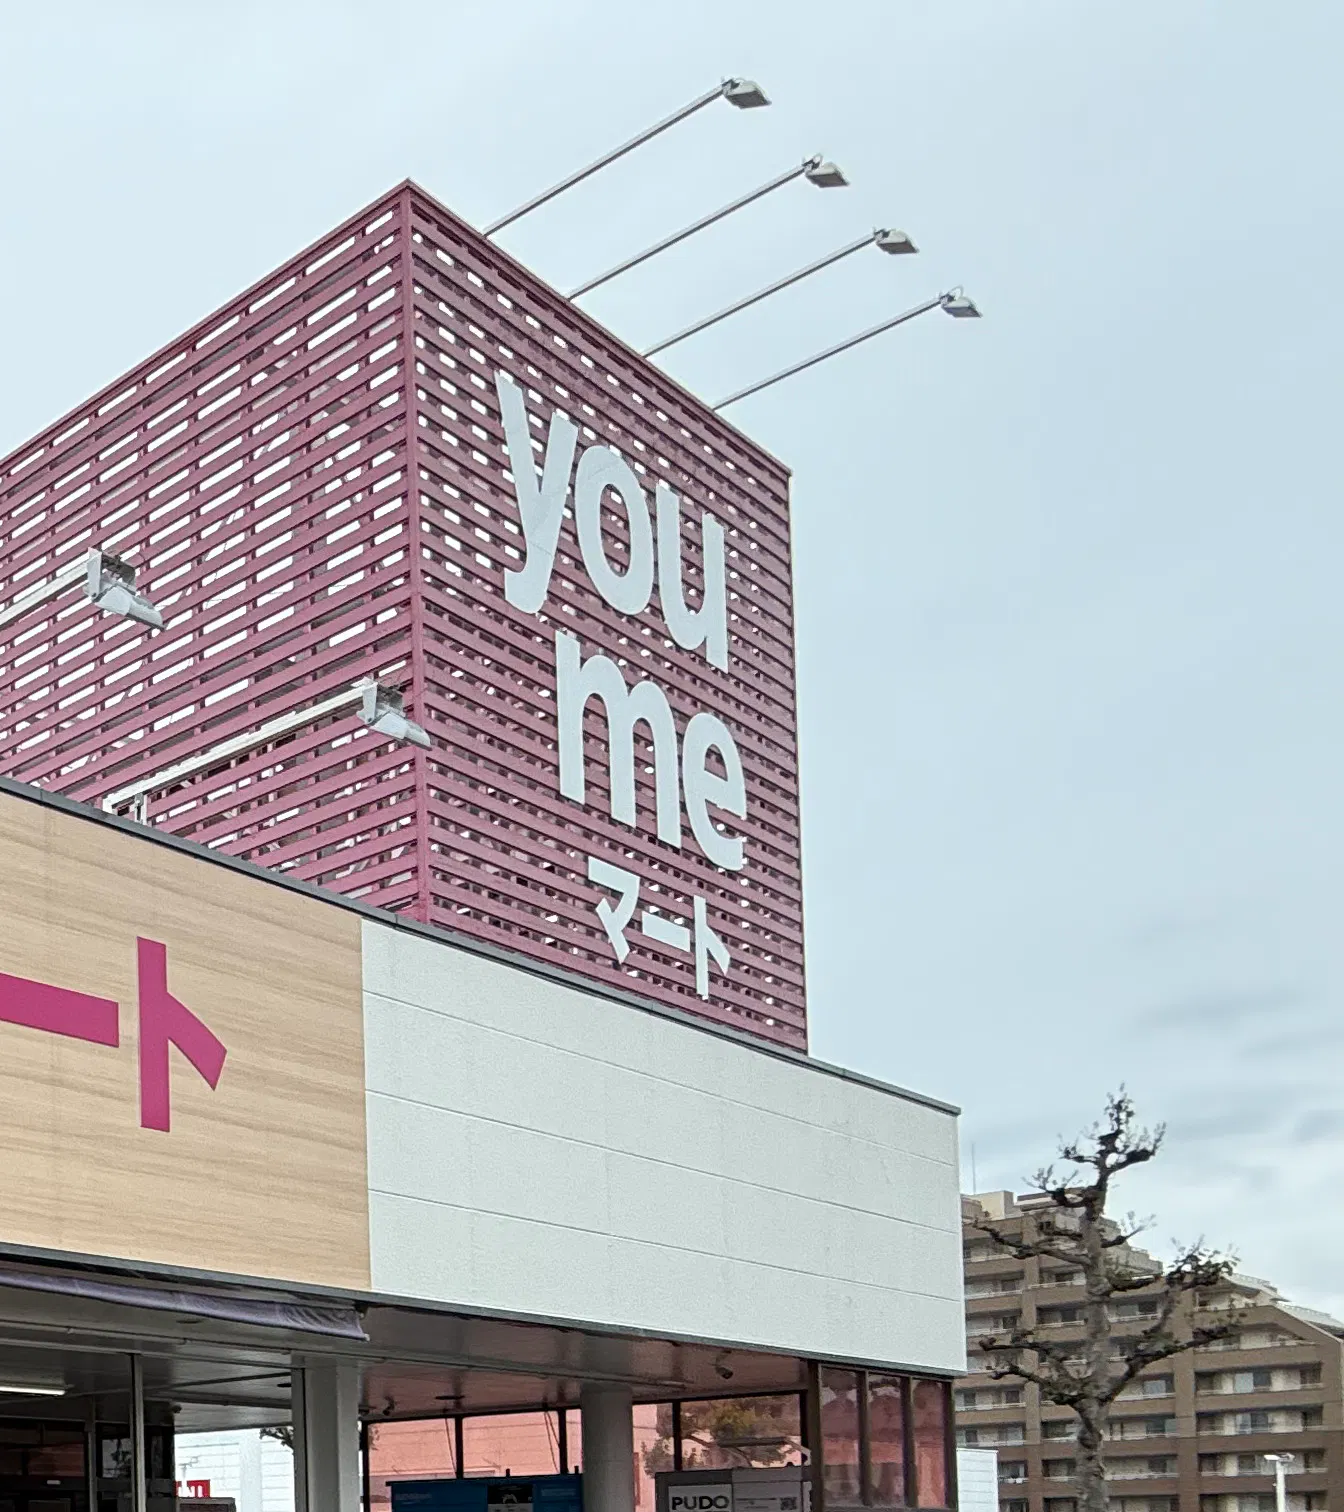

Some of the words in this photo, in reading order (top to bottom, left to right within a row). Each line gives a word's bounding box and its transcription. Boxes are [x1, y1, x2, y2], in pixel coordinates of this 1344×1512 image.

[494, 369, 729, 674] you
[555, 627, 748, 871] me
[588, 855, 731, 1001] マート
[671, 1495, 730, 1510] PUDO
